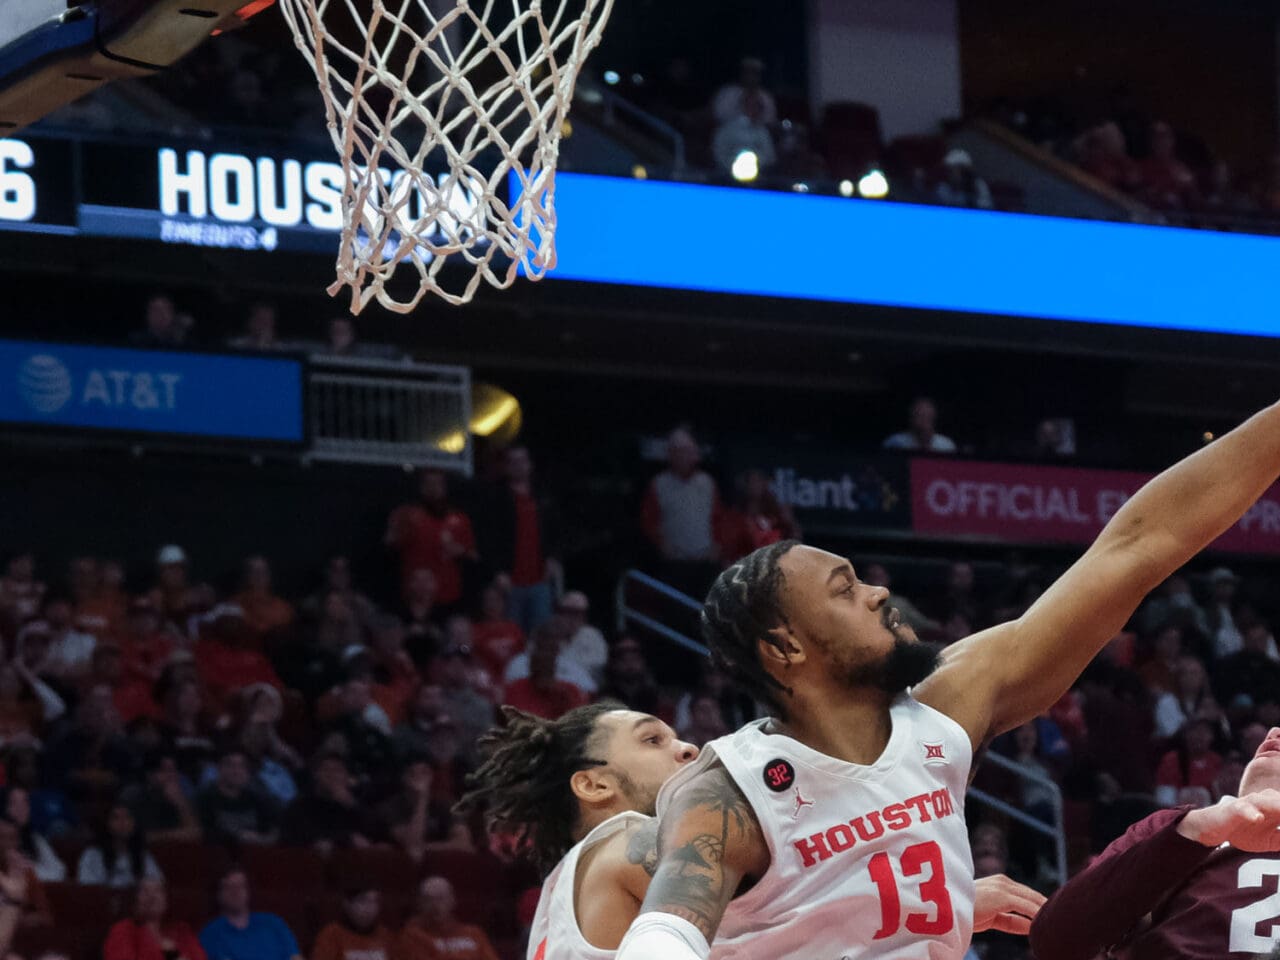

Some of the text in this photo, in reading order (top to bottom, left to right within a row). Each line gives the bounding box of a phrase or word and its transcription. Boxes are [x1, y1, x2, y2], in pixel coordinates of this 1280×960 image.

[82, 370, 182, 410] AT&T
[768, 468, 858, 511] liant
[924, 479, 1090, 524] OFFICIAL
[767, 764, 791, 787] 32
[866, 839, 954, 941] 13
